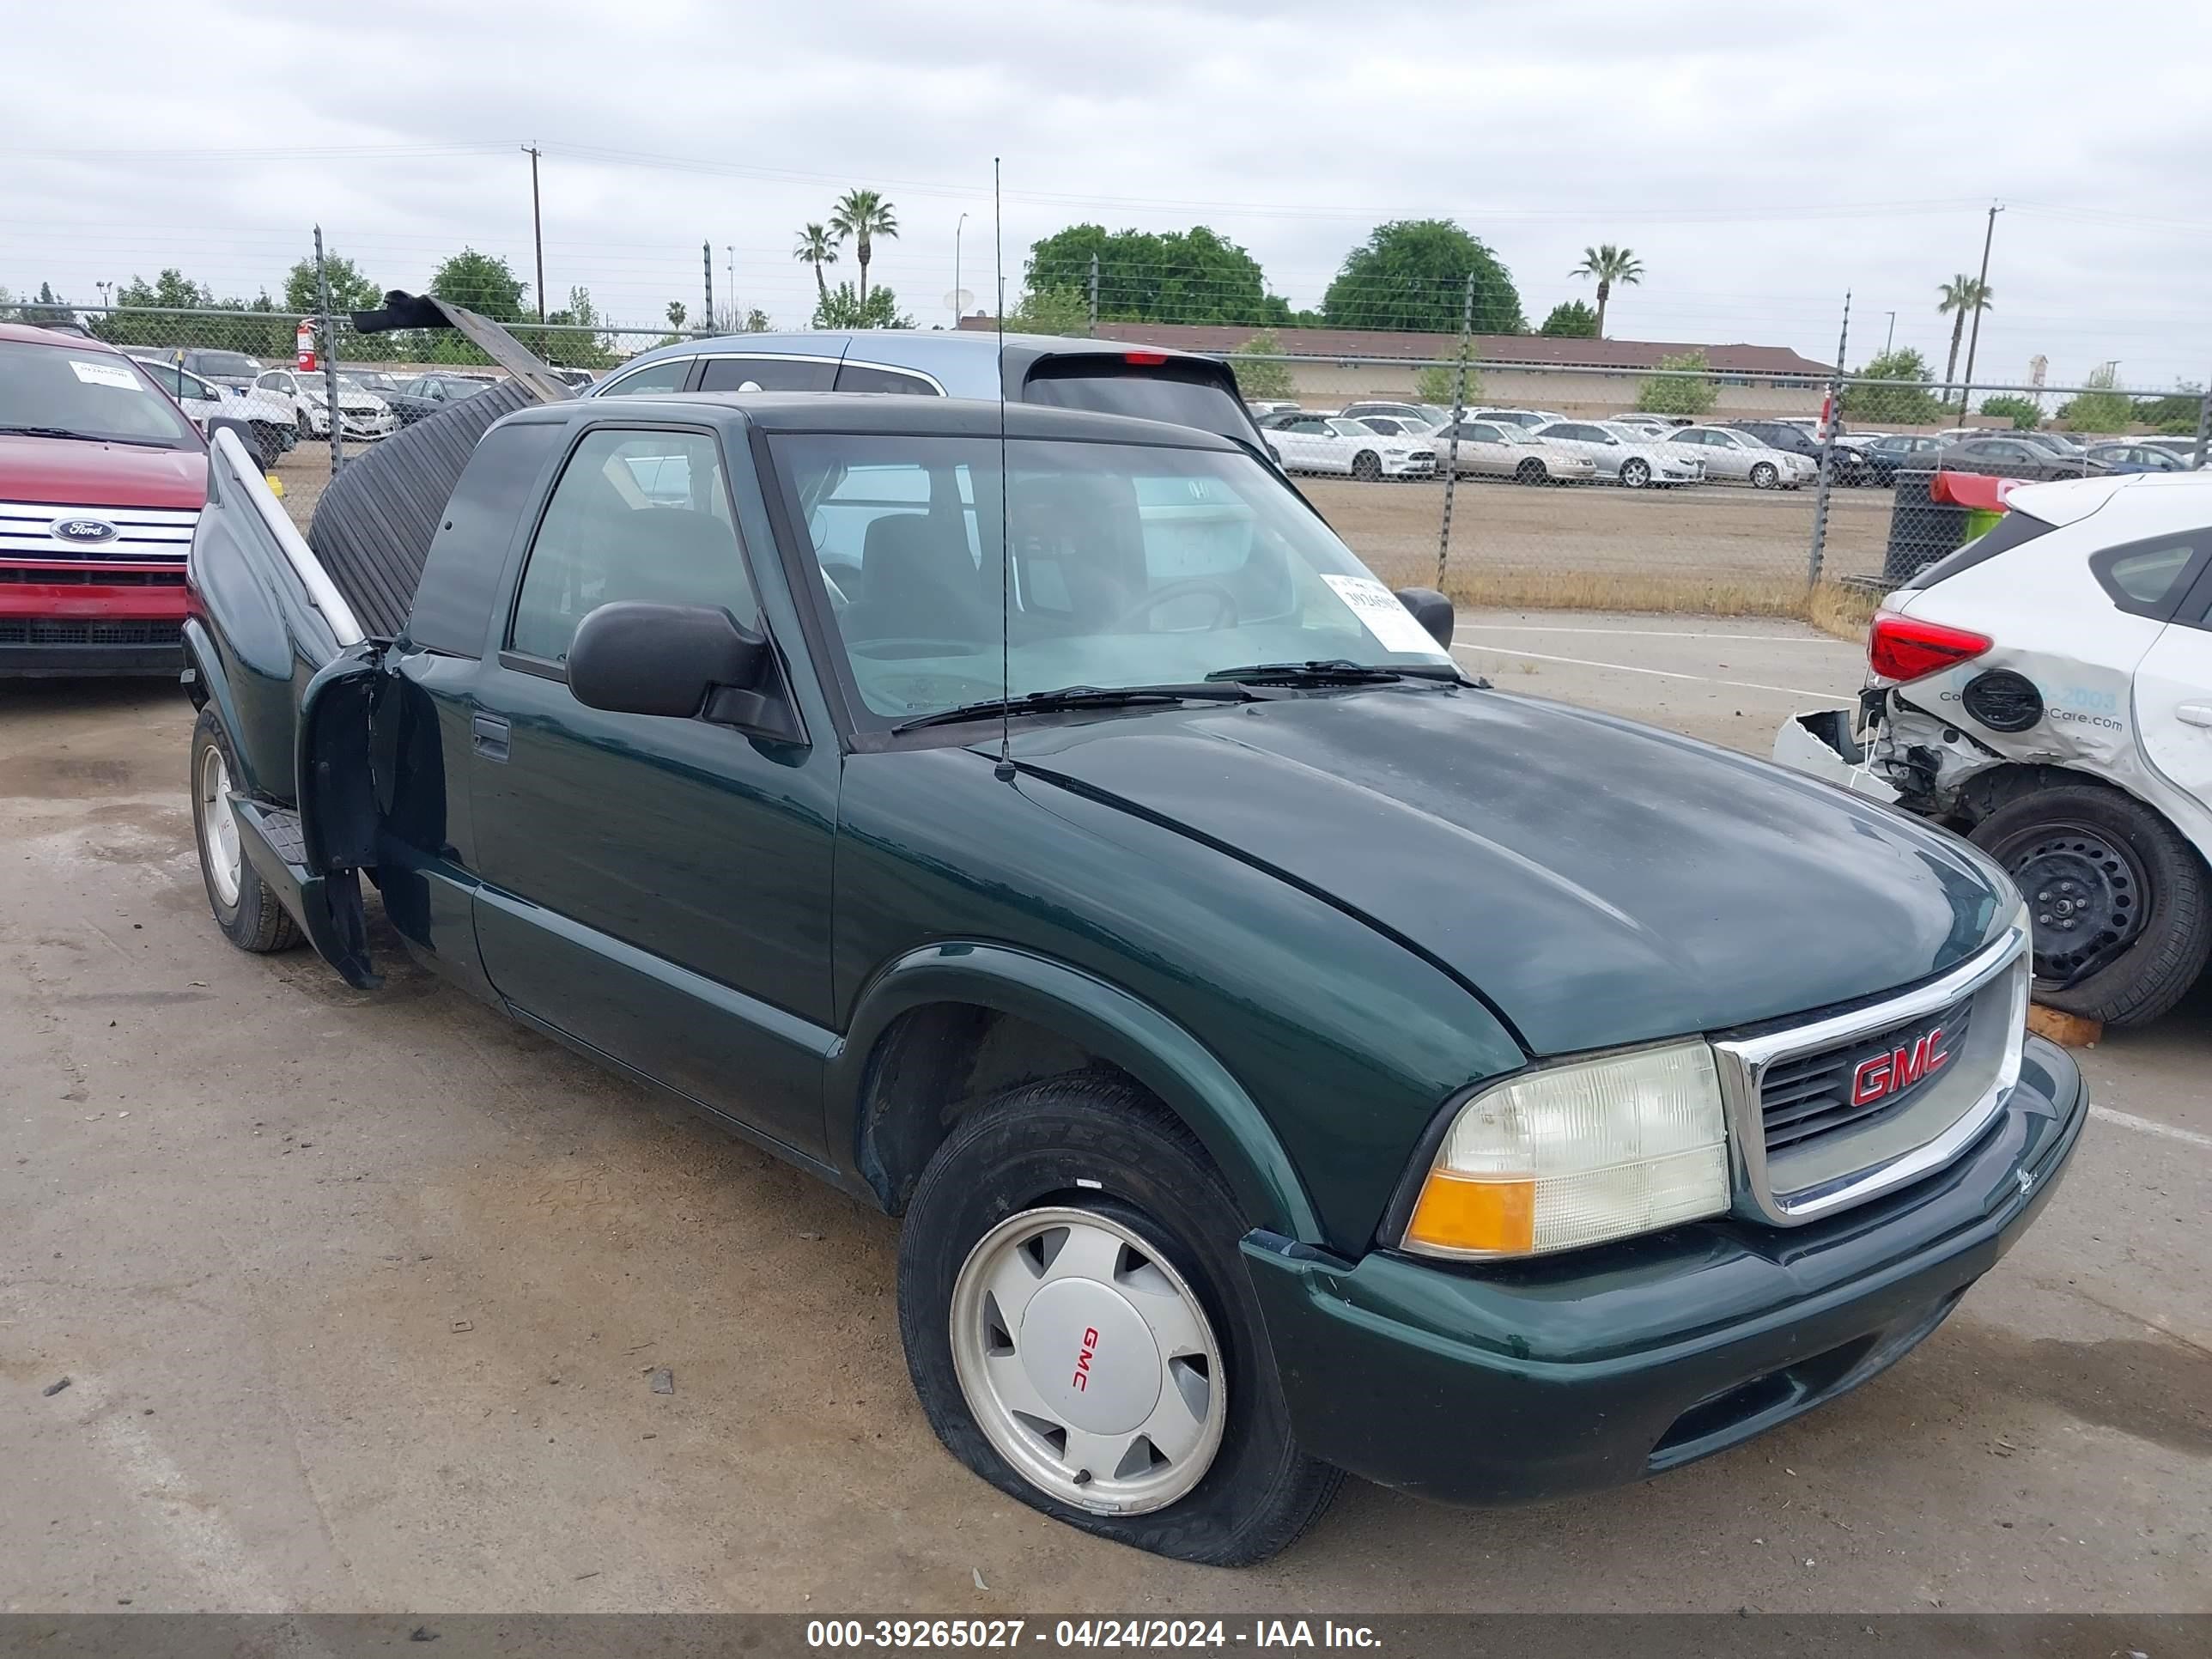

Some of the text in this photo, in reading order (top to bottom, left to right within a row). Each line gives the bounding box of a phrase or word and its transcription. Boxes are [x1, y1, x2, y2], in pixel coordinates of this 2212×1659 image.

[70, 522, 103, 535] Ford
[1850, 1027, 1948, 1107] GMC
[1072, 1327, 1099, 1392] GMC
